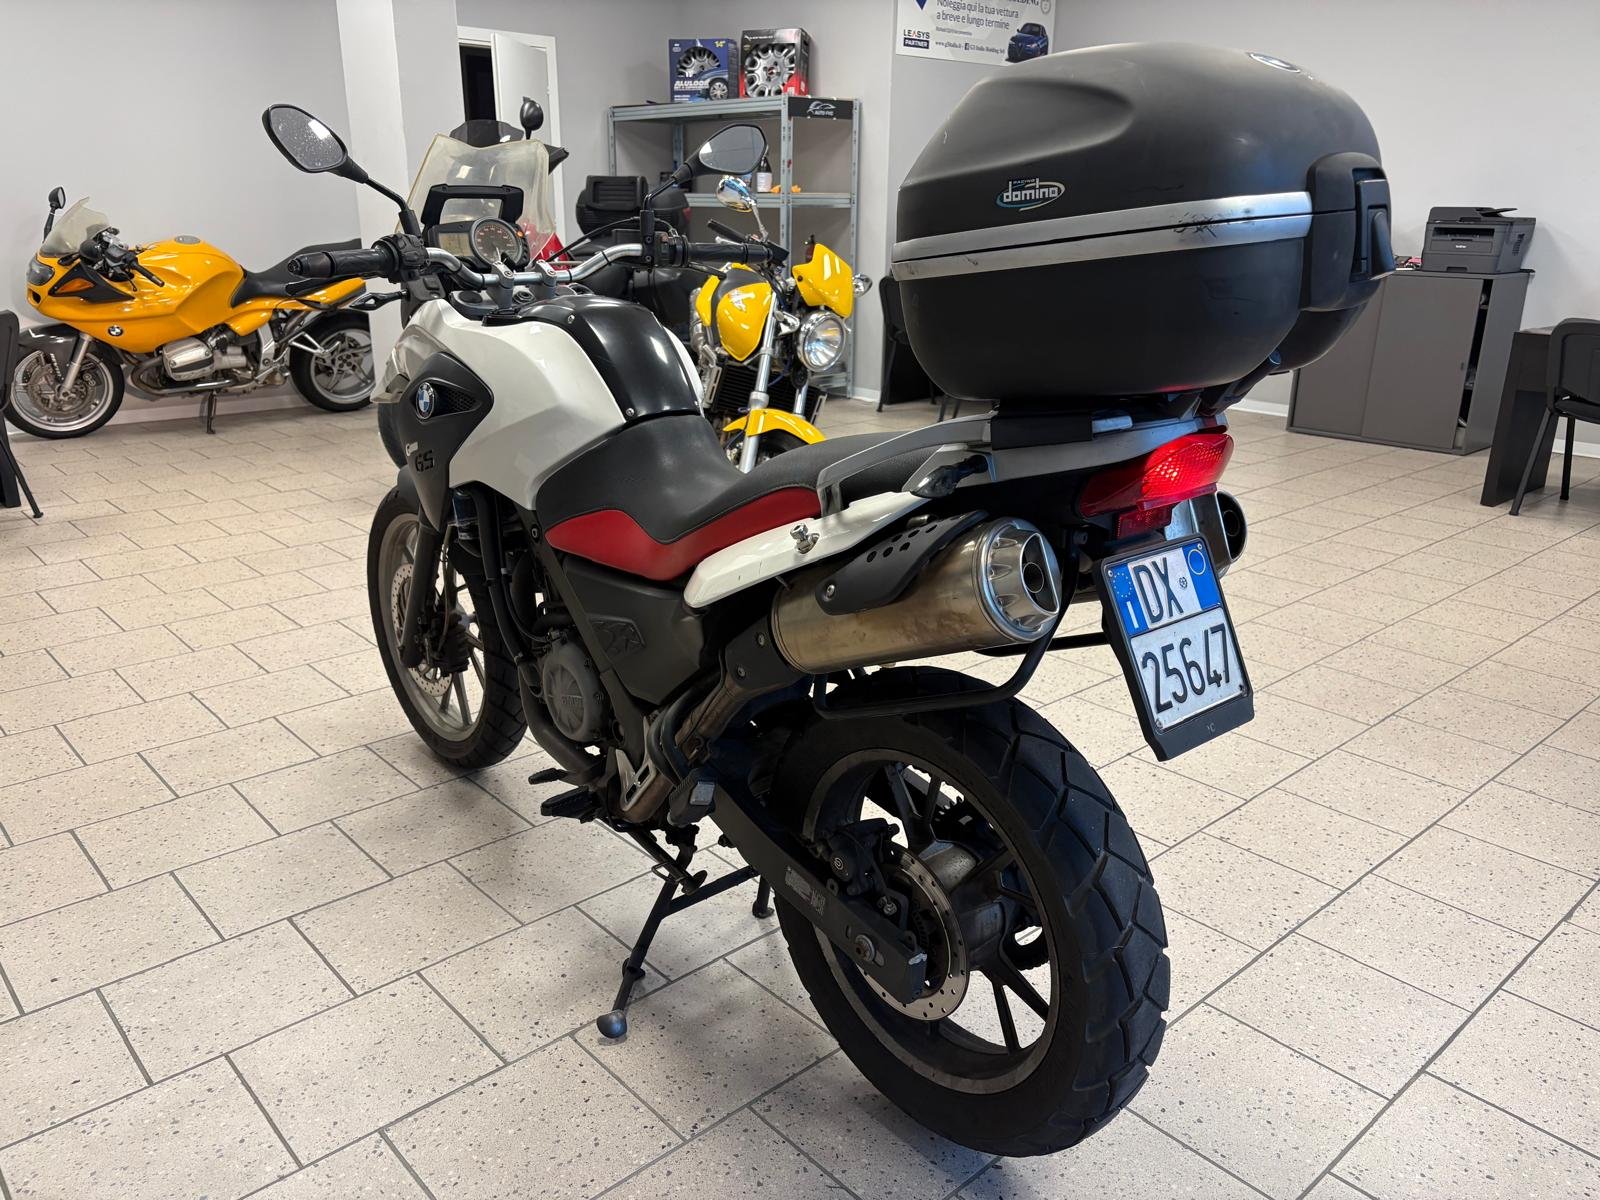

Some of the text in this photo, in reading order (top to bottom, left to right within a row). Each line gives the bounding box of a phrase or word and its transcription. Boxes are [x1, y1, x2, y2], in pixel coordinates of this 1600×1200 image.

[942, 10, 960, 22] breve
[966, 14, 985, 27] lungo
[985, 17, 1009, 30] termine
[967, 3, 977, 13] qui
[985, 6, 995, 15] tua
[996, 7, 1019, 18] vettura
[903, 29, 930, 39] LEASYS
[905, 39, 928, 47] PARTNER
[1003, 178, 1058, 202] domino
[1132, 557, 1184, 624] DX
[1141, 622, 1230, 714] 25647
